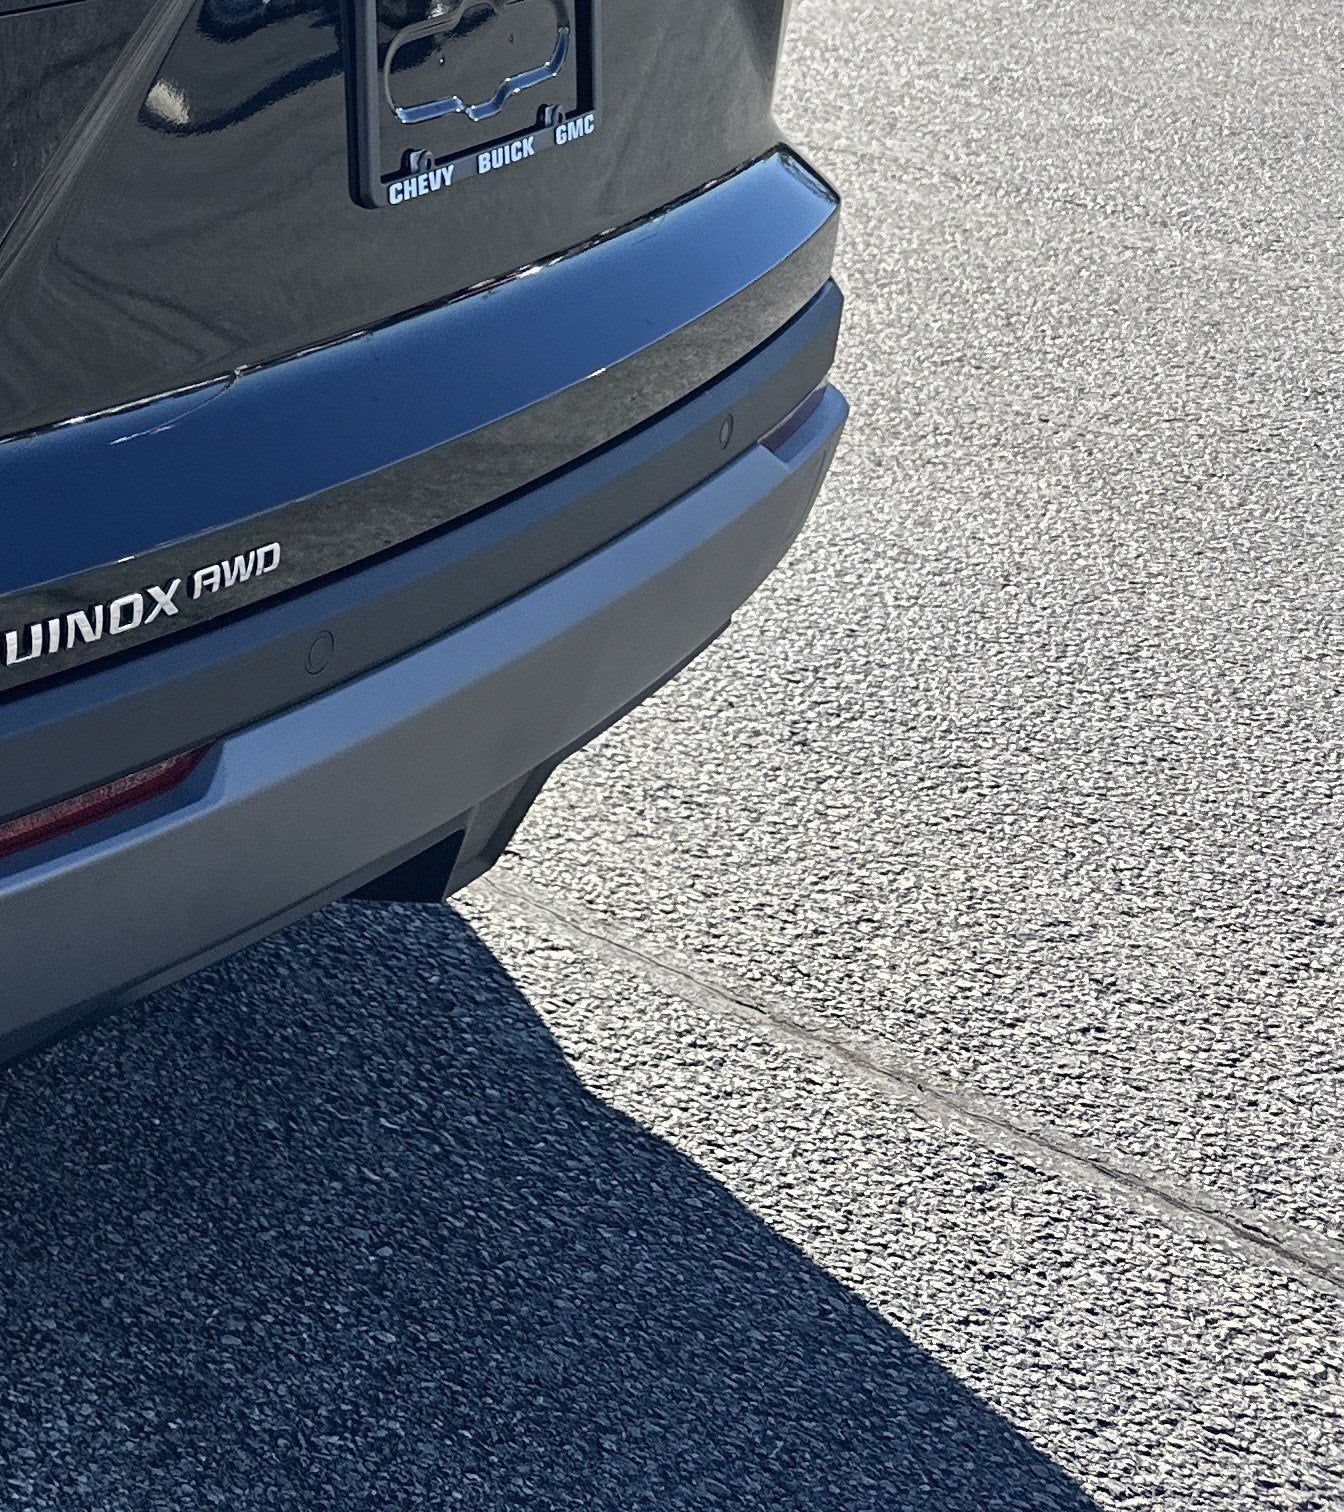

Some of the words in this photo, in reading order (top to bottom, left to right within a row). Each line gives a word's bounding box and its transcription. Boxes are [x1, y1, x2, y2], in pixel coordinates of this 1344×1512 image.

[388, 164, 455, 205] CHEVY
[477, 136, 535, 174] BUICK
[555, 114, 595, 146] GMC
[192, 542, 282, 600] AWD
